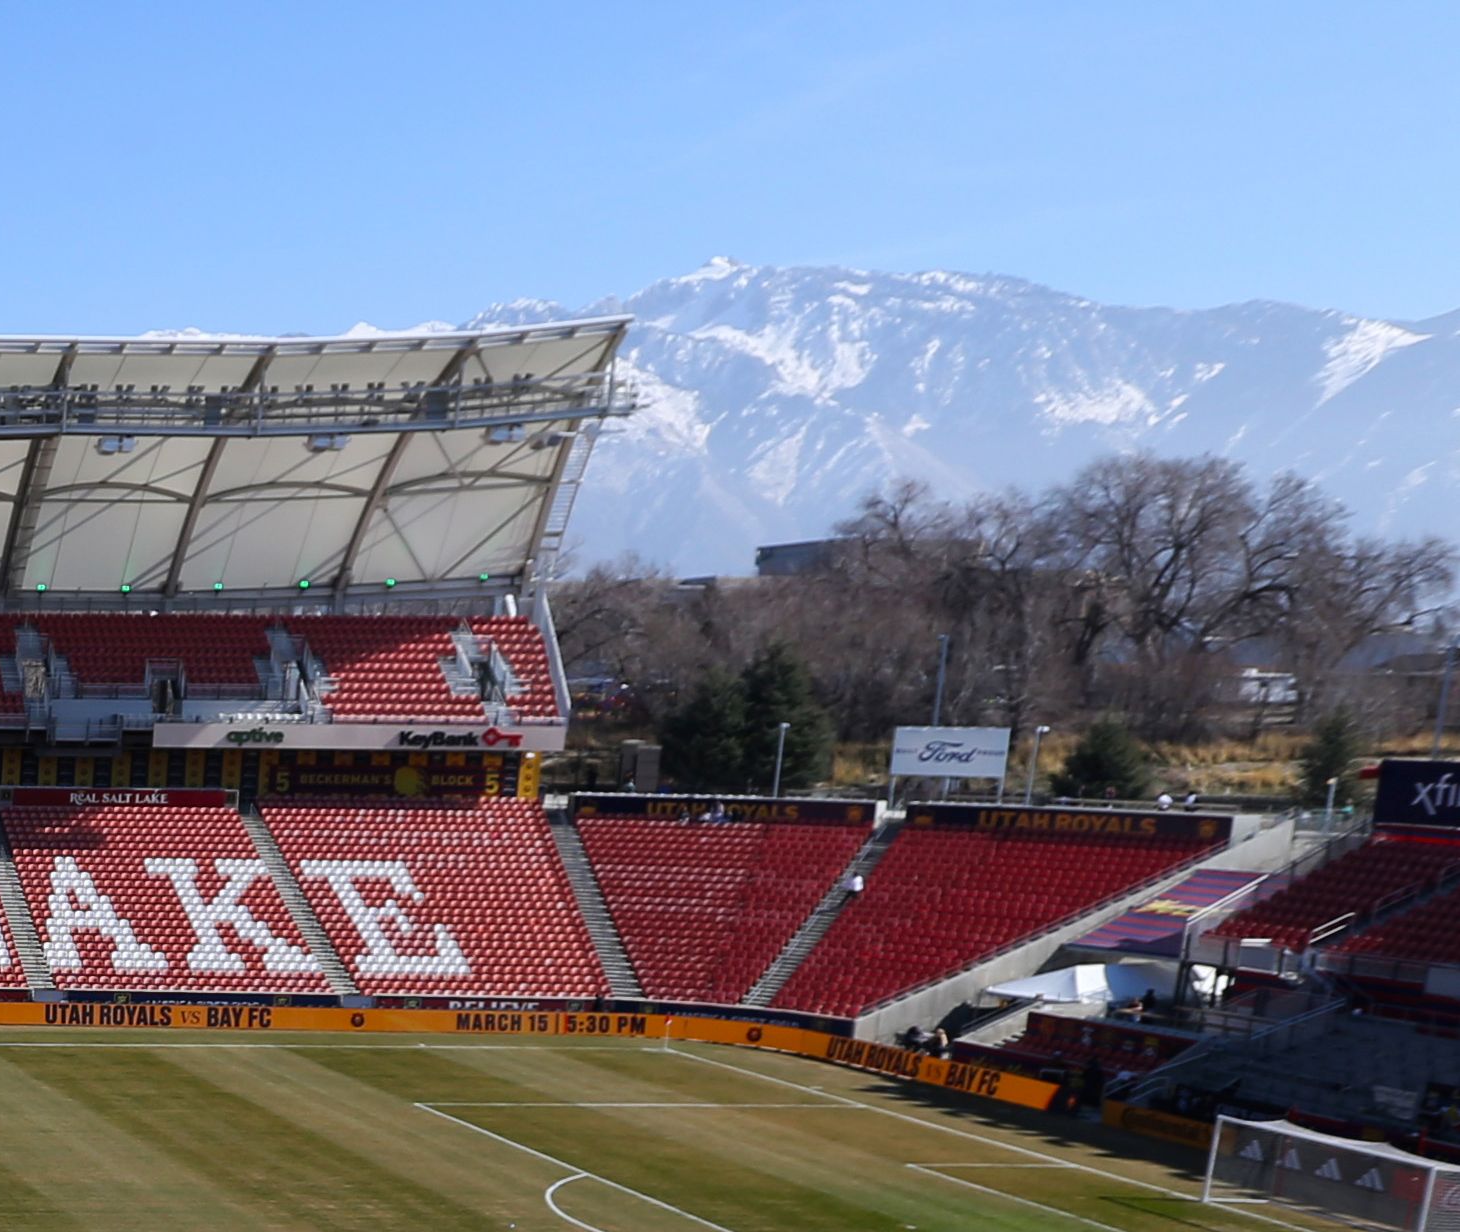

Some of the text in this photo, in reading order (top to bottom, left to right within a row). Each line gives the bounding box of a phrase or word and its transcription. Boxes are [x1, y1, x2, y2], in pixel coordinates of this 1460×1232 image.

[226, 730, 284, 746] aptive
[398, 731, 479, 747] KeyBank
[918, 741, 978, 763] Ford
[276, 772, 499, 794] 5 BECKERMAN'S BLOCK 5
[70, 792, 169, 805] REAL SALT LAKE
[710, 803, 799, 820] OYALS
[980, 811, 1158, 834] UTAH ROYALS
[45, 1004, 272, 1028] UTAH ROYALS VS BAY FC
[456, 1013, 646, 1034] MARCH 15 5:30 PM
[828, 1037, 864, 1066] UTAH
[863, 1045, 921, 1077] ROYALS
[945, 1062, 978, 1092] BAY
[980, 1069, 1001, 1096] FC
